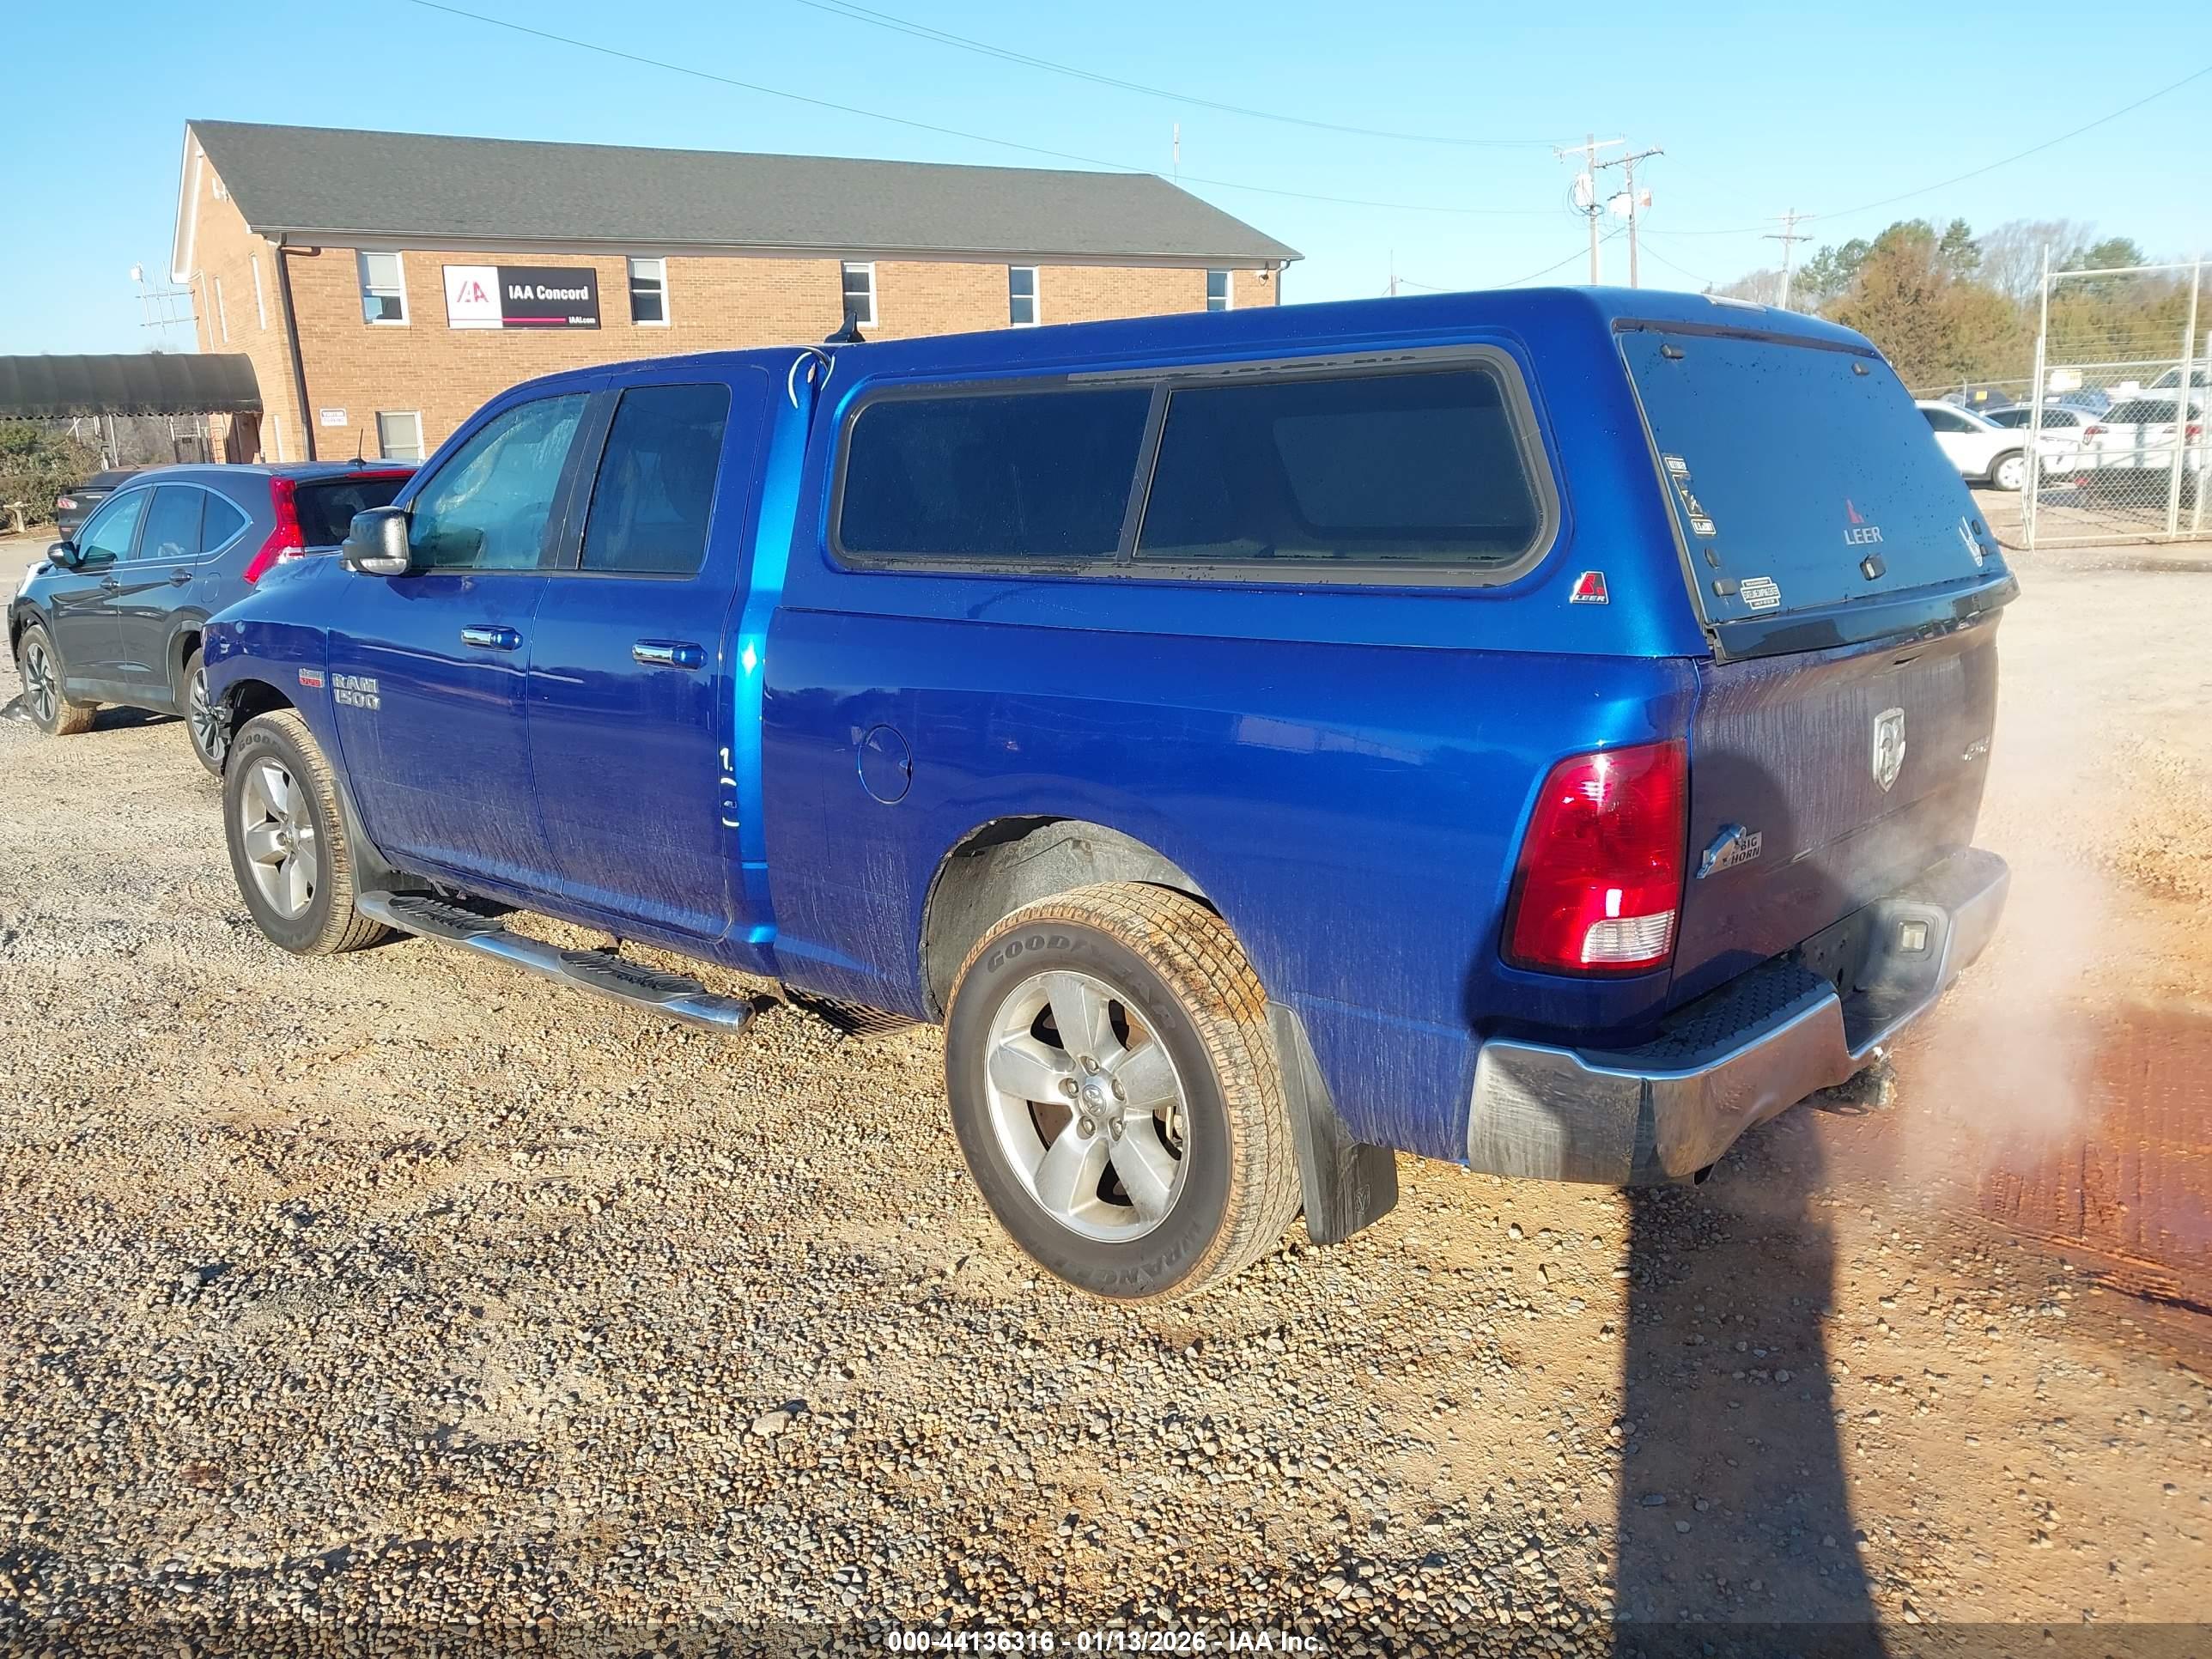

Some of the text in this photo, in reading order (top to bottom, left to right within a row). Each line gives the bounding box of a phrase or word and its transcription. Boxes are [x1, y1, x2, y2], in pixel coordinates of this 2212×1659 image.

[508, 285, 589, 301] IAA Concord
[1844, 526, 1884, 545] LEER
[332, 672, 379, 693] RAM
[333, 689, 381, 710] 1500
[1741, 836, 1758, 851] BIG
[1731, 846, 1760, 865] HORN
